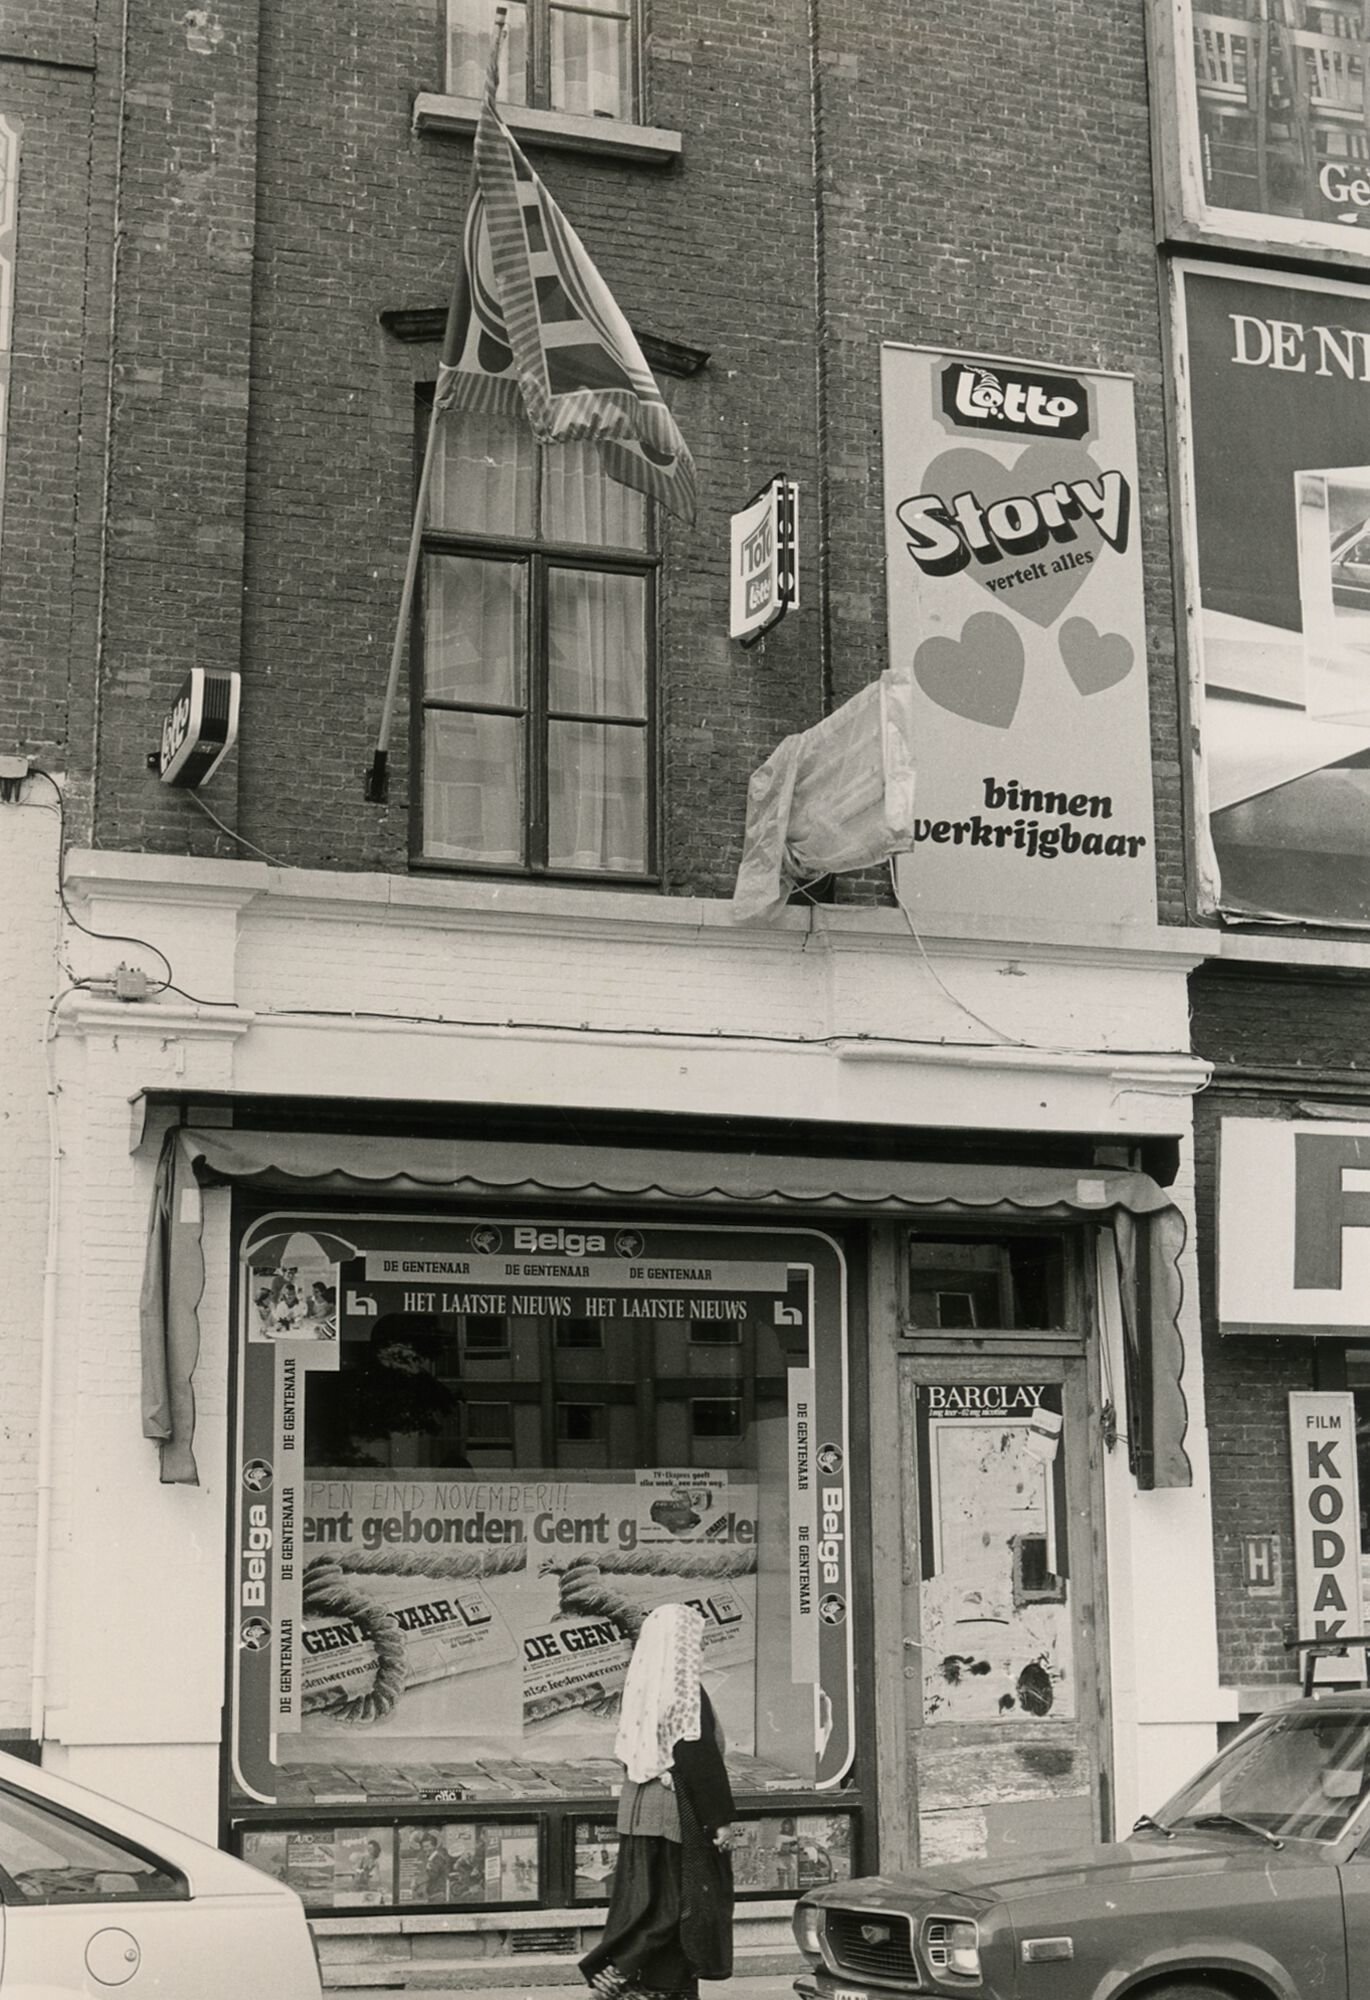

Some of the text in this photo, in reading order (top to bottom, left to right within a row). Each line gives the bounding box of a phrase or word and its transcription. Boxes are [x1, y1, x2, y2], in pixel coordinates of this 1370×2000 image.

[1228, 313, 1307, 373] DE
[955, 371, 1079, 428] Lotto
[896, 469, 1131, 578] Story
[984, 550, 1095, 593] vertelt alles
[982, 777, 1113, 819] binnen
[914, 815, 1147, 859] verkrijgbaar
[514, 1227, 606, 1257] Belga
[383, 1260, 470, 1275] DE GENTENAAR
[504, 1263, 590, 1278] DE GENTENAAR
[629, 1267, 712, 1281] DE GENTENAAR
[403, 1292, 572, 1317] HET LAATSTE NIEUWS
[585, 1297, 748, 1319] HET LAATSTE NIEUWS
[283, 1358, 296, 1450] DE GENTENAAR
[928, 1386, 1045, 1408] BARCLAY
[1306, 1415, 1341, 1429] FILM
[797, 1403, 808, 1490] DE GENTENAAR
[373, 1484, 425, 1510] EIND
[282, 1487, 294, 1580] DE GENTENAAR
[533, 1512, 609, 1544] Gent
[818, 1487, 844, 1583] Belga
[242, 1504, 272, 1606] Belga
[799, 1526, 810, 1614] DE GENTENAAR
[1249, 1542, 1270, 1581] H
[280, 1619, 292, 1713] DE GENTENAAR
